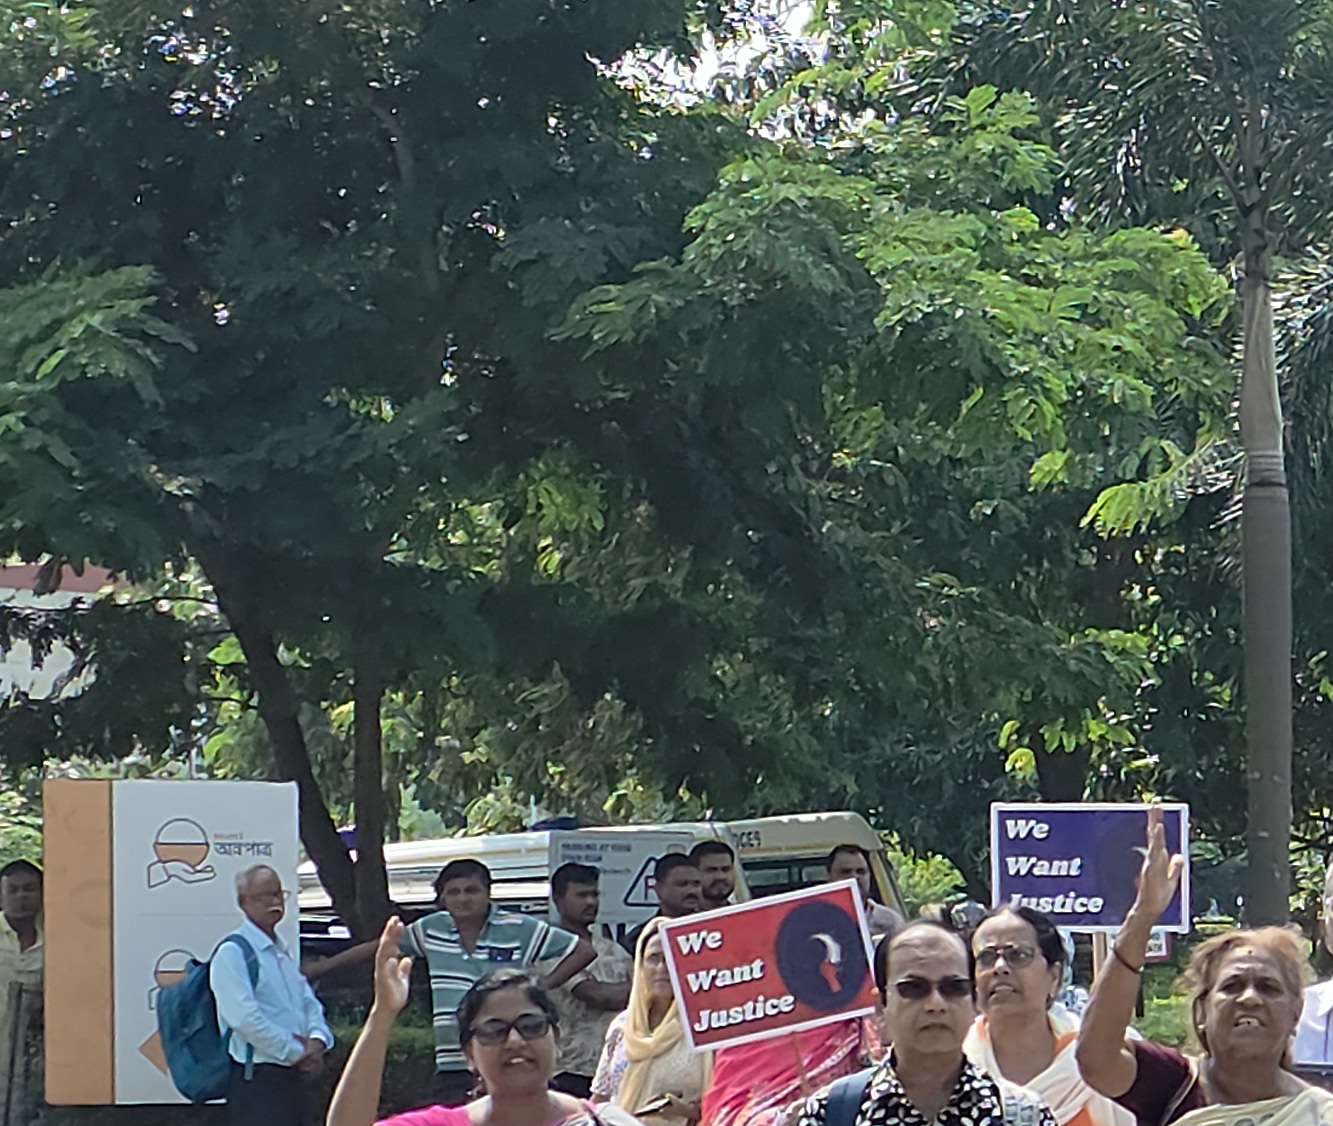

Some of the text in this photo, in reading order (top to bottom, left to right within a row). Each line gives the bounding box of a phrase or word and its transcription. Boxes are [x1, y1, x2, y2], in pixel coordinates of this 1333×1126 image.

[1005, 819, 1050, 840] We
[1005, 856, 1082, 877] Want
[1010, 891, 1104, 914] Justice
[677, 930, 723, 956] We
[686, 957, 765, 995] Want
[693, 994, 796, 1033] Justice
